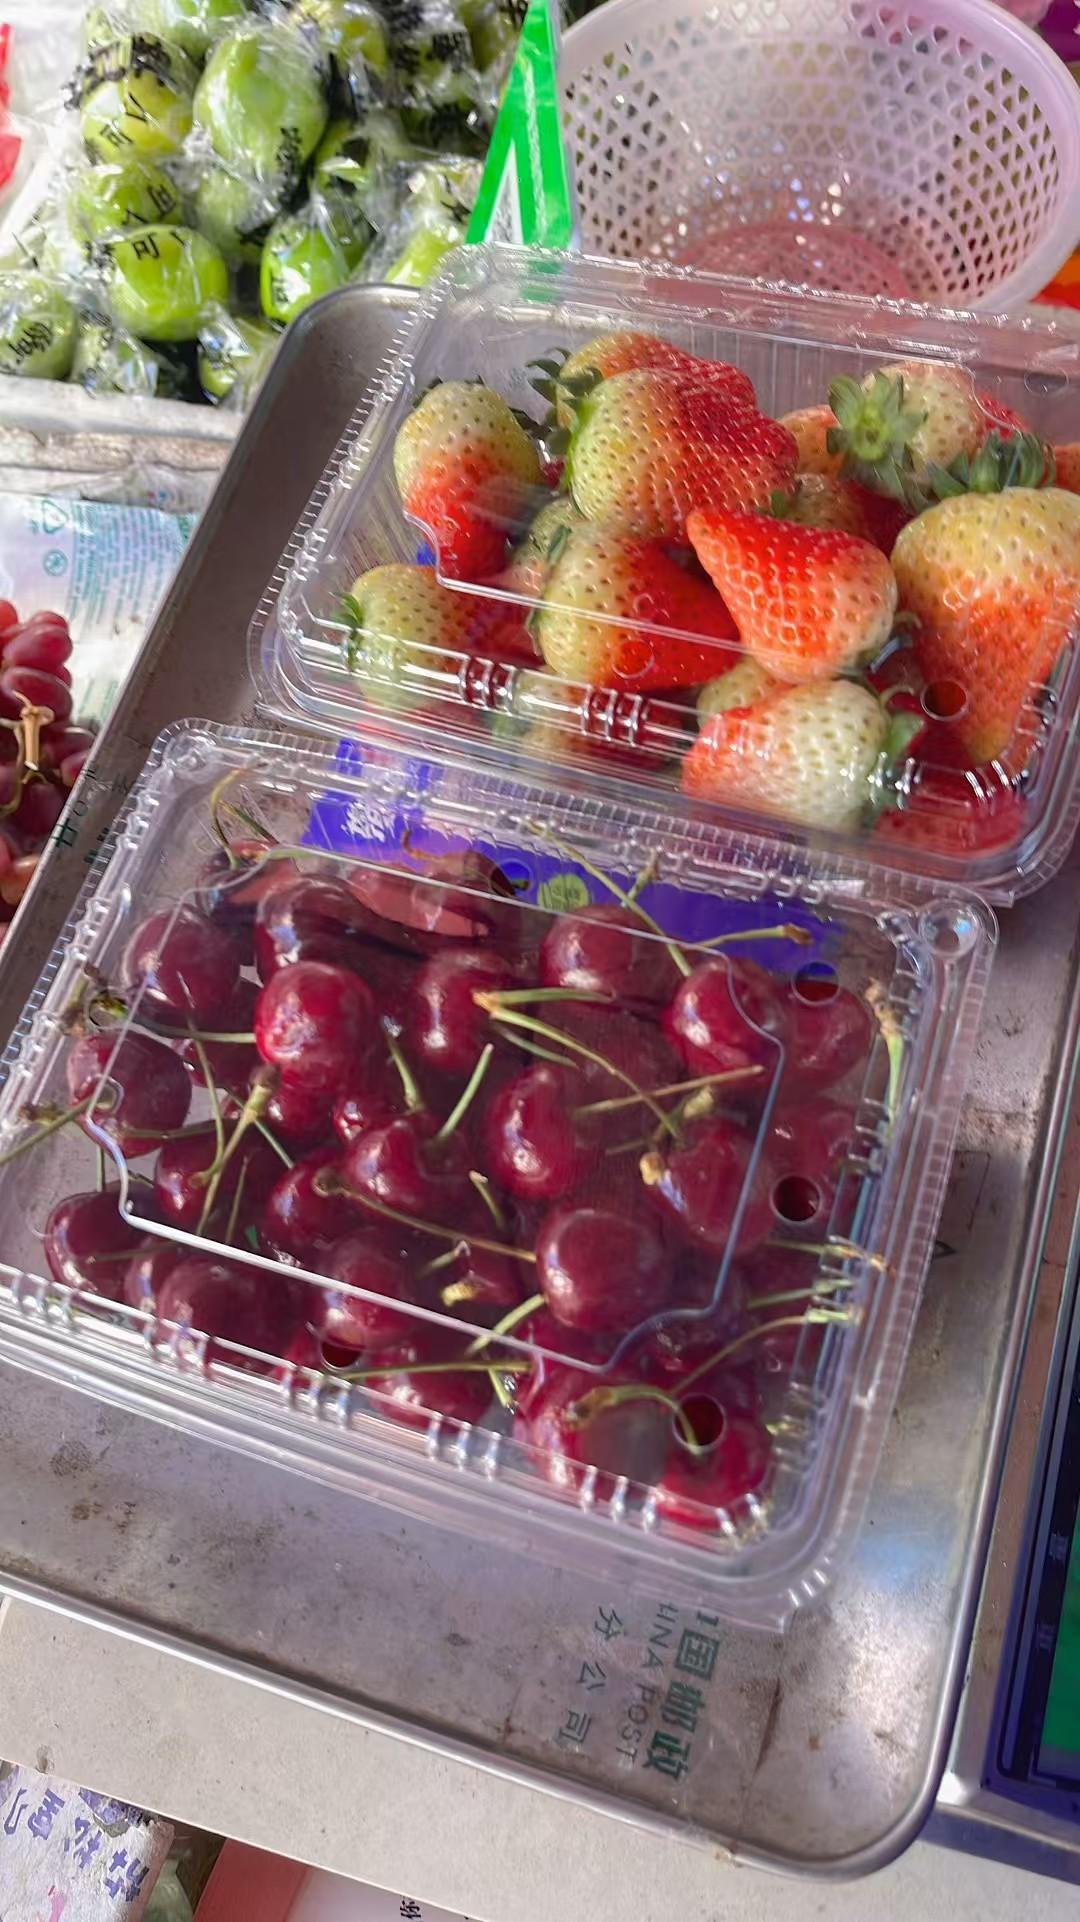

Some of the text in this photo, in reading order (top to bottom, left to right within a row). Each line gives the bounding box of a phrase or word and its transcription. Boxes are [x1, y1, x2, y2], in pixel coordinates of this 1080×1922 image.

[556, 1606, 625, 1746] 分公司
[615, 1682, 661, 1764] POST
